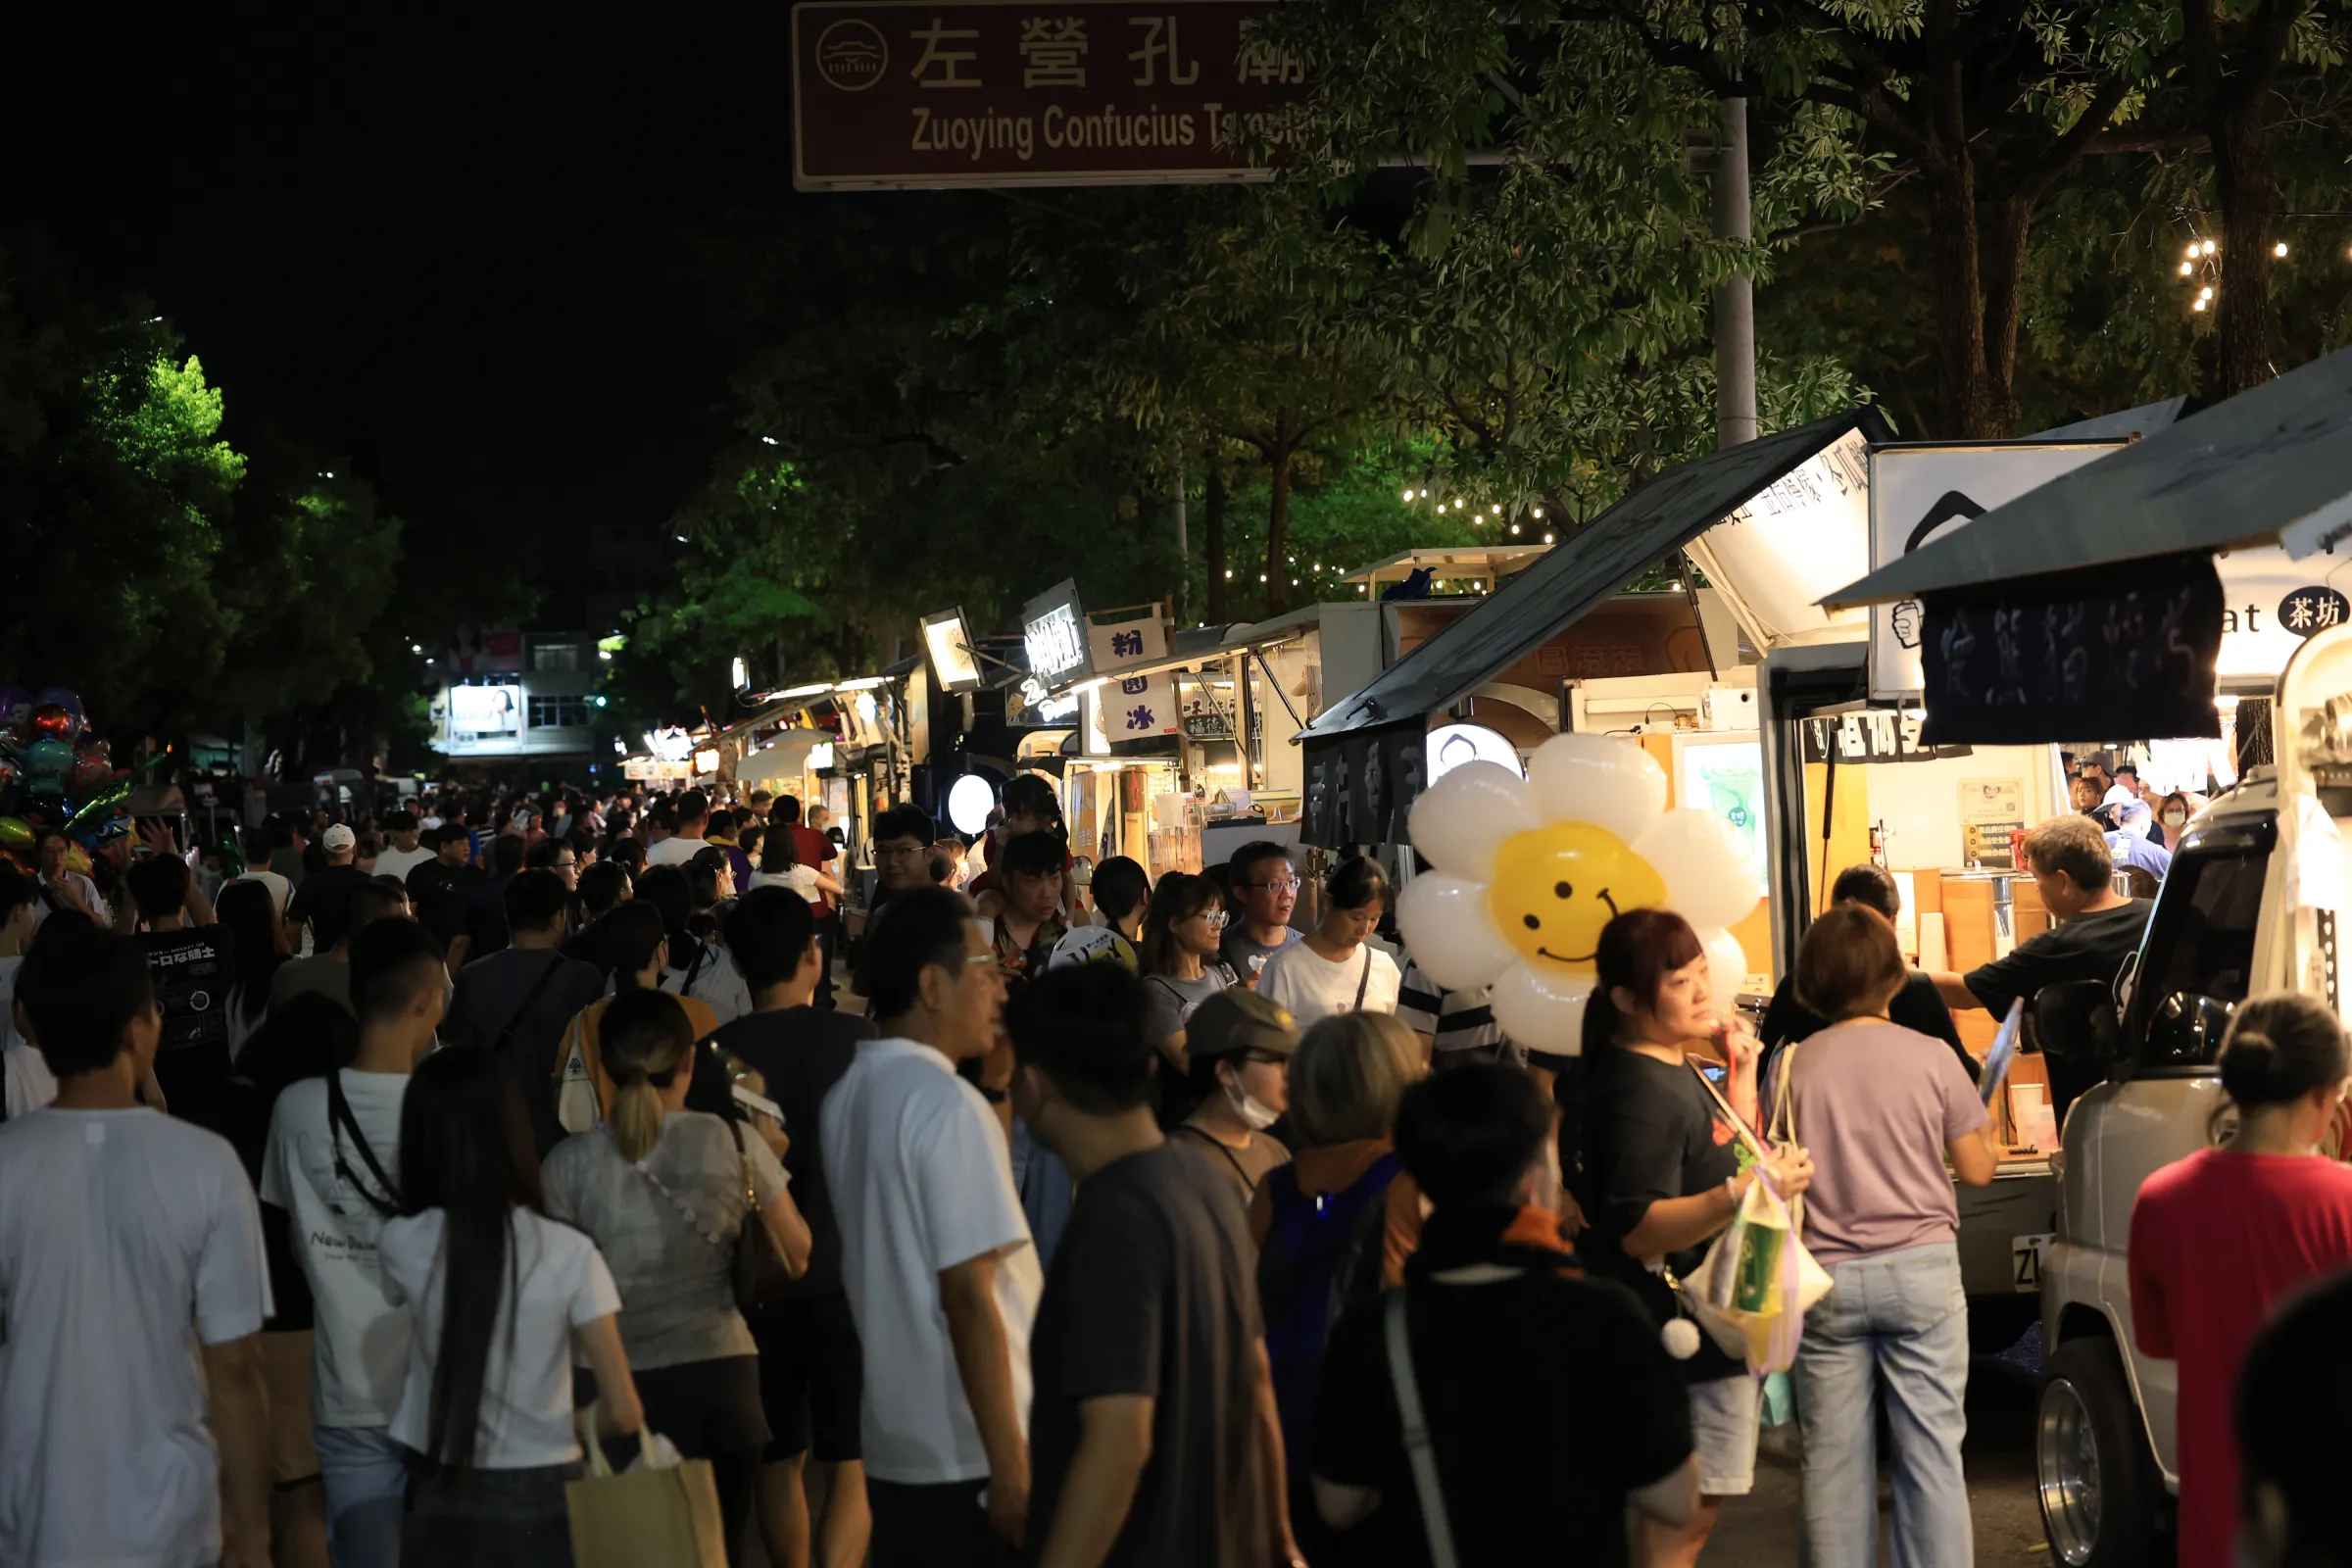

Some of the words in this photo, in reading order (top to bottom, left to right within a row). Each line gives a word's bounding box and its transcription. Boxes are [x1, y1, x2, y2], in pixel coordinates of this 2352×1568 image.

[911, 107, 1033, 160] Zuoying
[1043, 103, 1196, 149] Confucius
[2289, 596, 2341, 629] 茶坊
